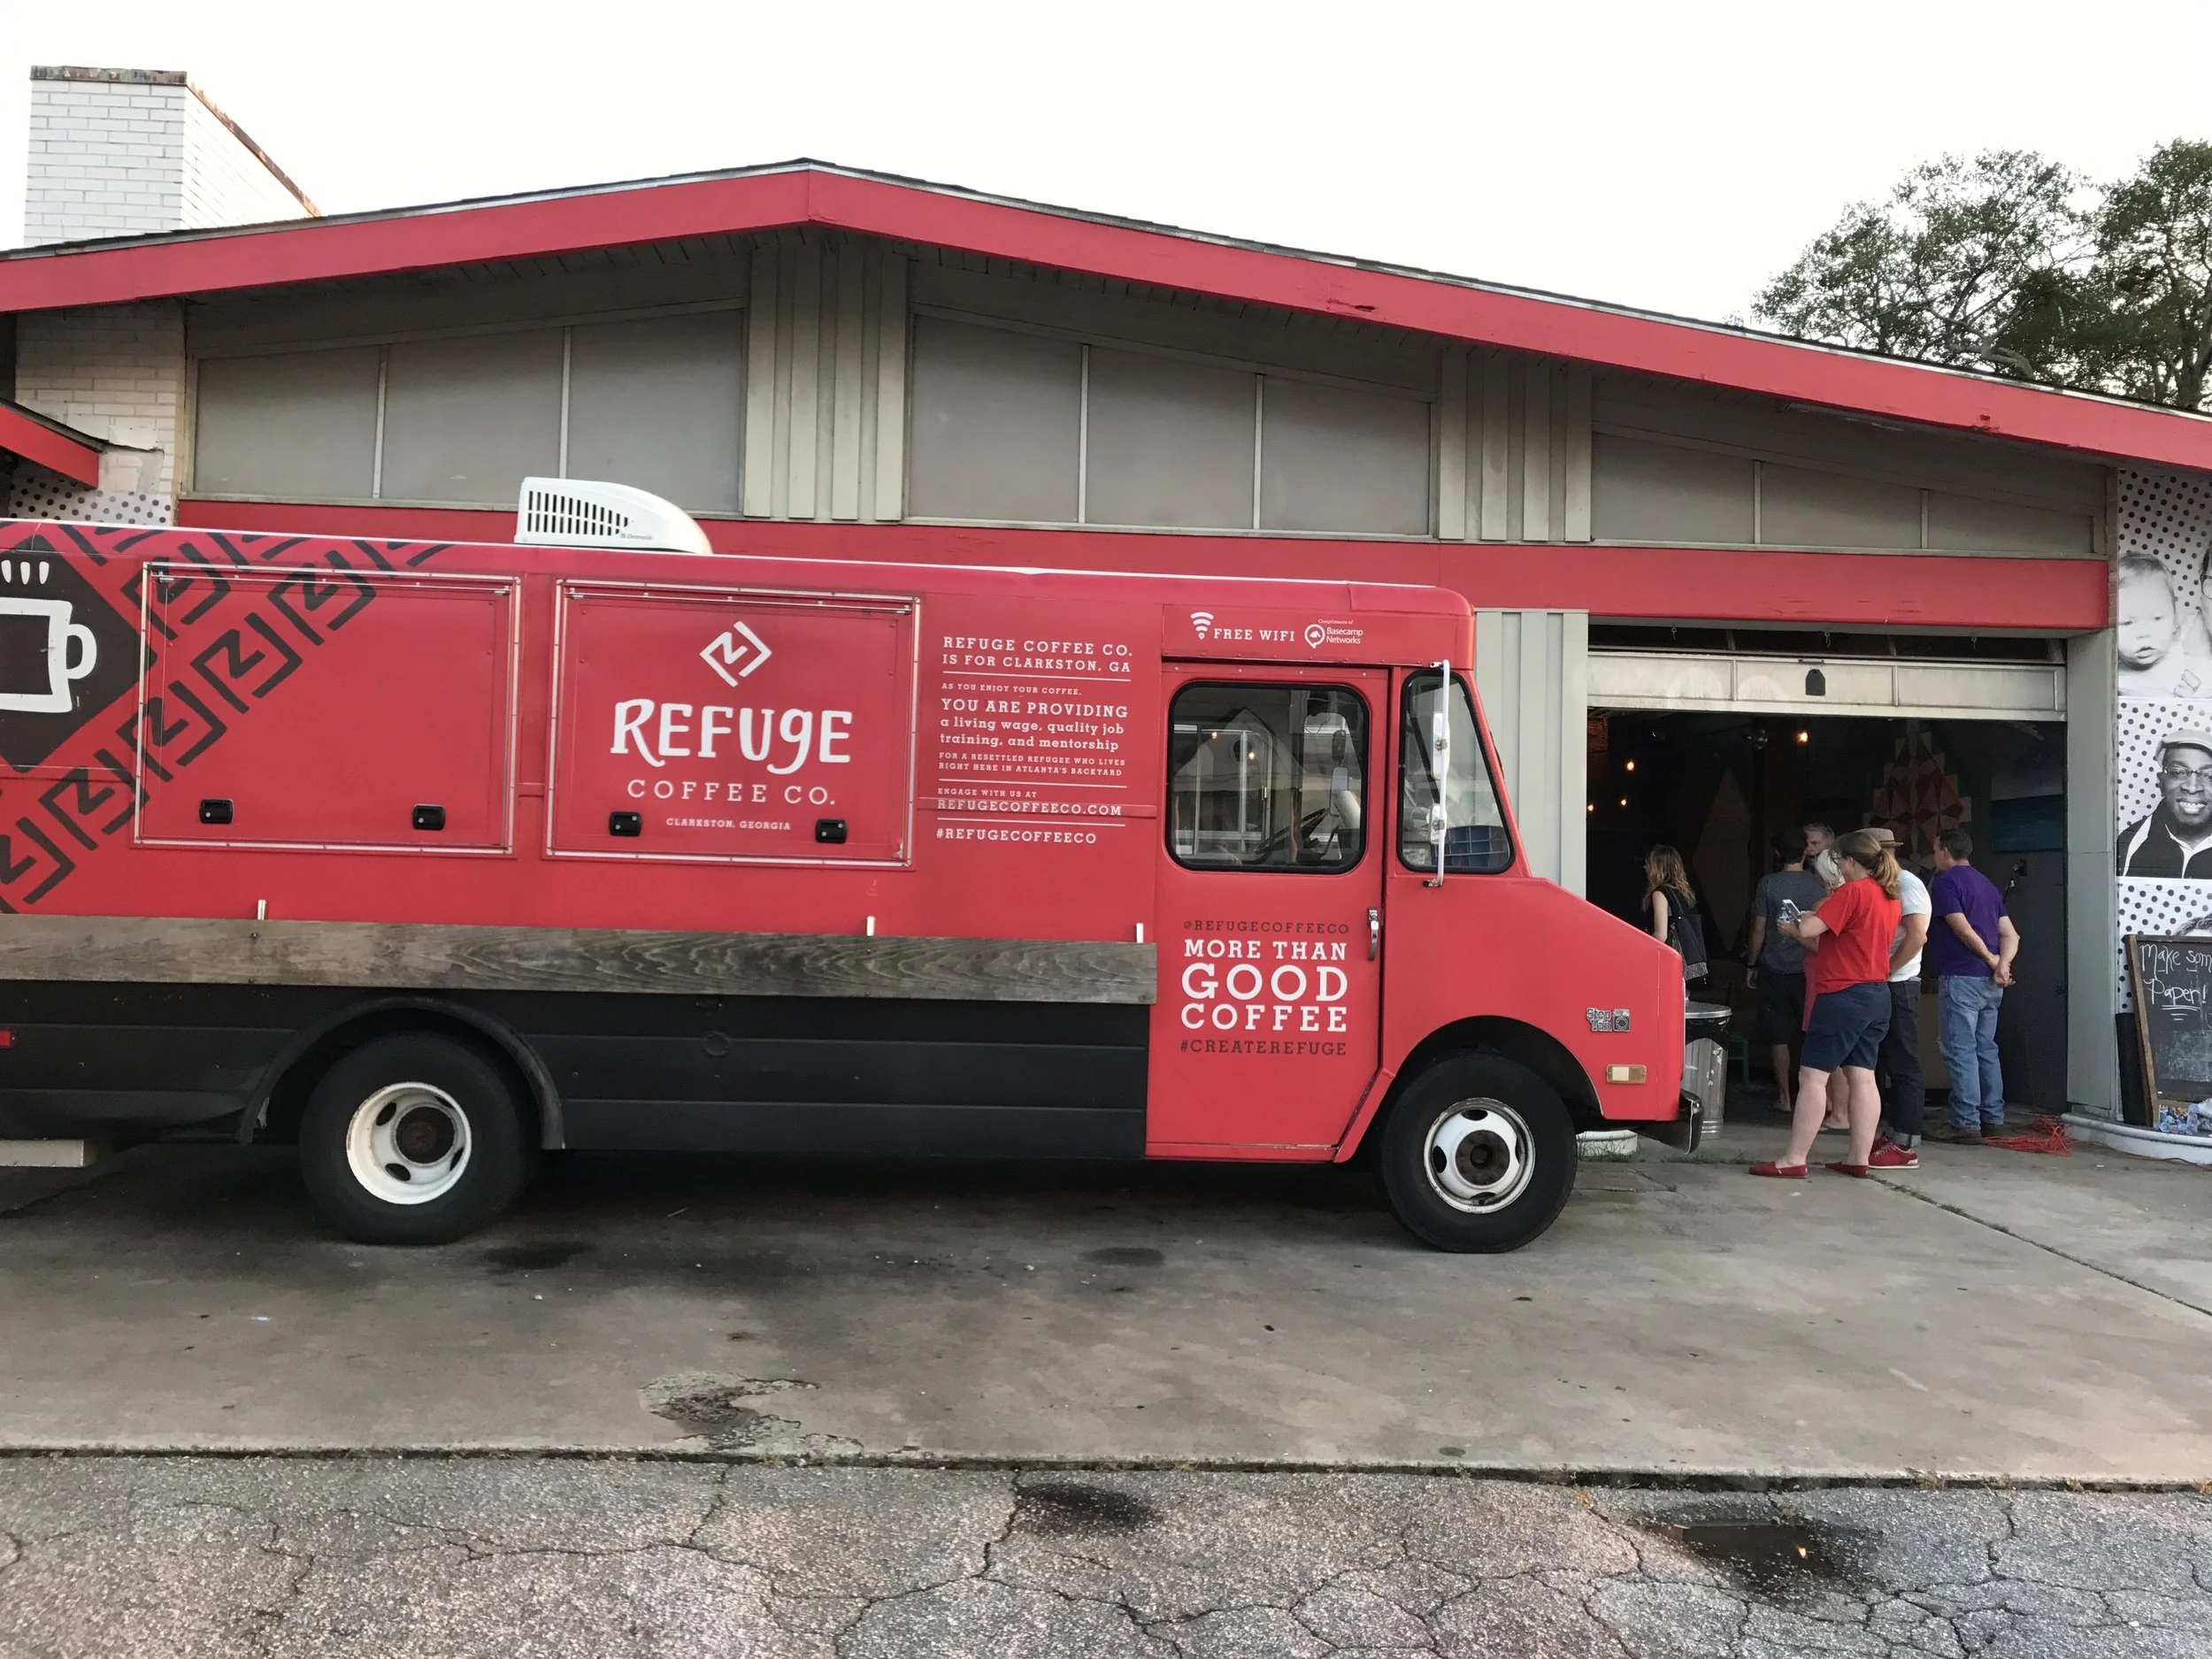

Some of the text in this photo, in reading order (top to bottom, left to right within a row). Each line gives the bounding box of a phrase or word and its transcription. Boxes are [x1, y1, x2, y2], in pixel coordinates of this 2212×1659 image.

[1213, 628, 1294, 641] FREE WIFI
[1326, 626, 1363, 637] Basecamp
[1326, 635, 1361, 644] Networks
[943, 636, 1133, 657] REFUGE COFFEE CO.
[942, 654, 1131, 672] IS FOR CLARKSTON, GA
[941, 698, 1128, 718] YOU ARE PROVIDING
[953, 717, 995, 731] living
[1001, 721, 1042, 733] wage,
[1047, 722, 1098, 735] quality
[1102, 724, 1124, 735] job
[940, 733, 1118, 752] training, and mentorship
[1016, 765, 1067, 774] ATLANTA'S
[627, 779, 835, 805] COFFEE CO.
[937, 800, 1122, 815] REFUGECOFFEECO.COM
[740, 820, 791, 830] GEORGIA
[935, 828, 1097, 843] #REFUGECOFFEECO
[1183, 919, 1349, 934] @REFUGECOFFEECO
[1184, 939, 1347, 960] MORE THAN
[2139, 943, 2181, 979] Make
[1181, 962, 1348, 1002] GOOD
[1180, 1002, 1347, 1033] COFFEE
[1586, 1008, 1611, 1023] Step
[1180, 1039, 1347, 1056] #CREATEREFUGE
